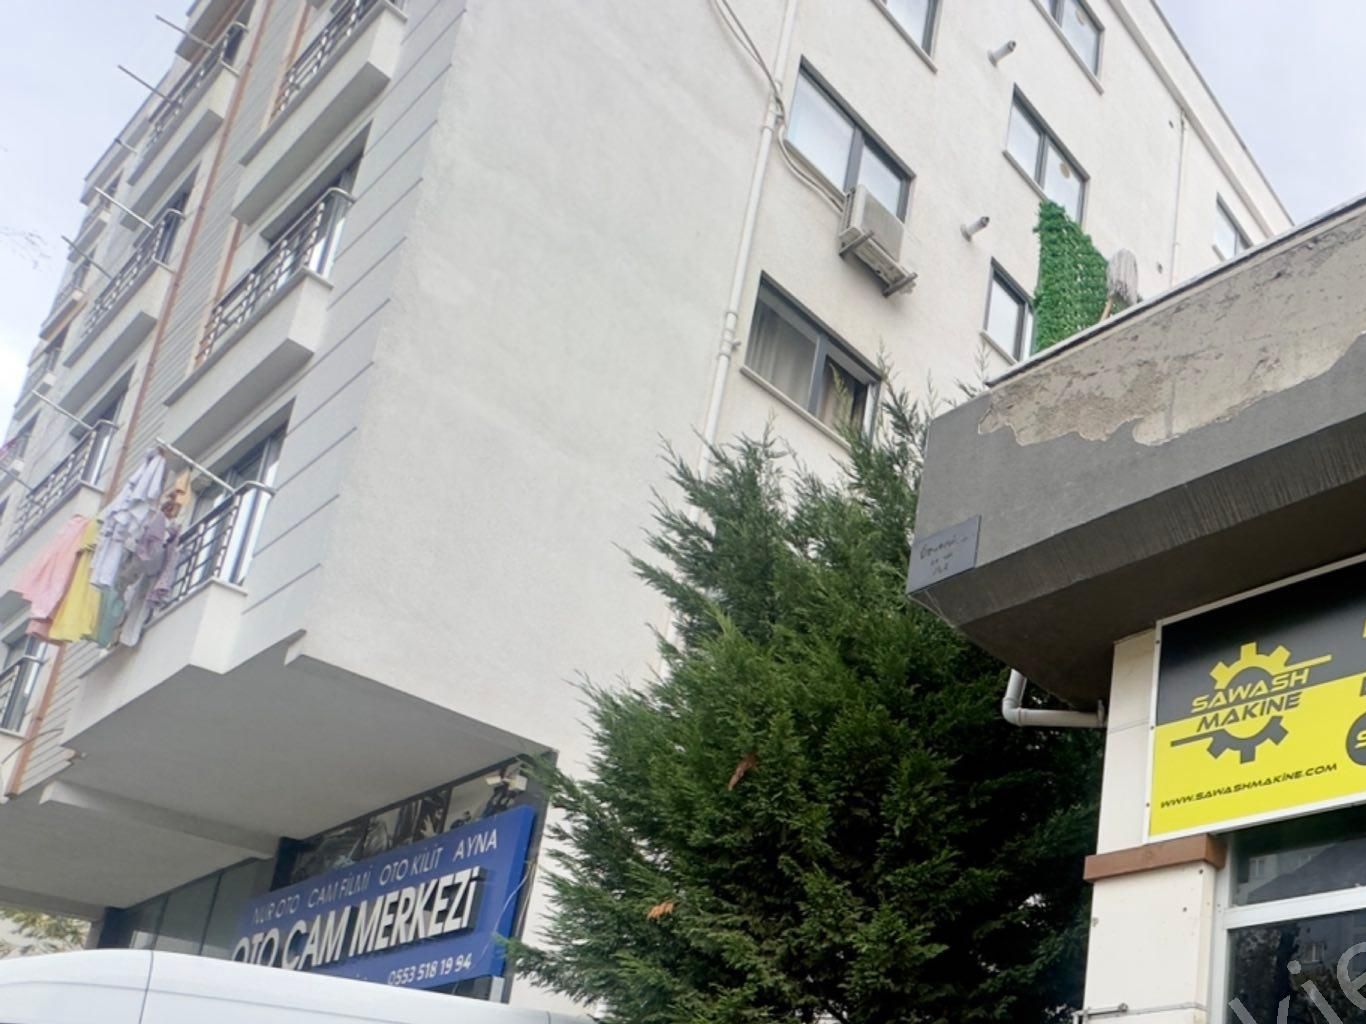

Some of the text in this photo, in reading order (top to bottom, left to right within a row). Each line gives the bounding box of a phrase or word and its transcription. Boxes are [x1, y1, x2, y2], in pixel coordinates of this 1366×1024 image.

[1191, 668, 1310, 713] SAWASH
[379, 858, 409, 887] OTO
[452, 828, 497, 862] AYNA
[283, 905, 351, 972] CAM
[349, 866, 480, 958] MERKEZİ
[387, 965, 417, 985] 0553
[417, 960, 438, 980] 518
[440, 957, 453, 975] 19
[454, 952, 473, 972] 94
